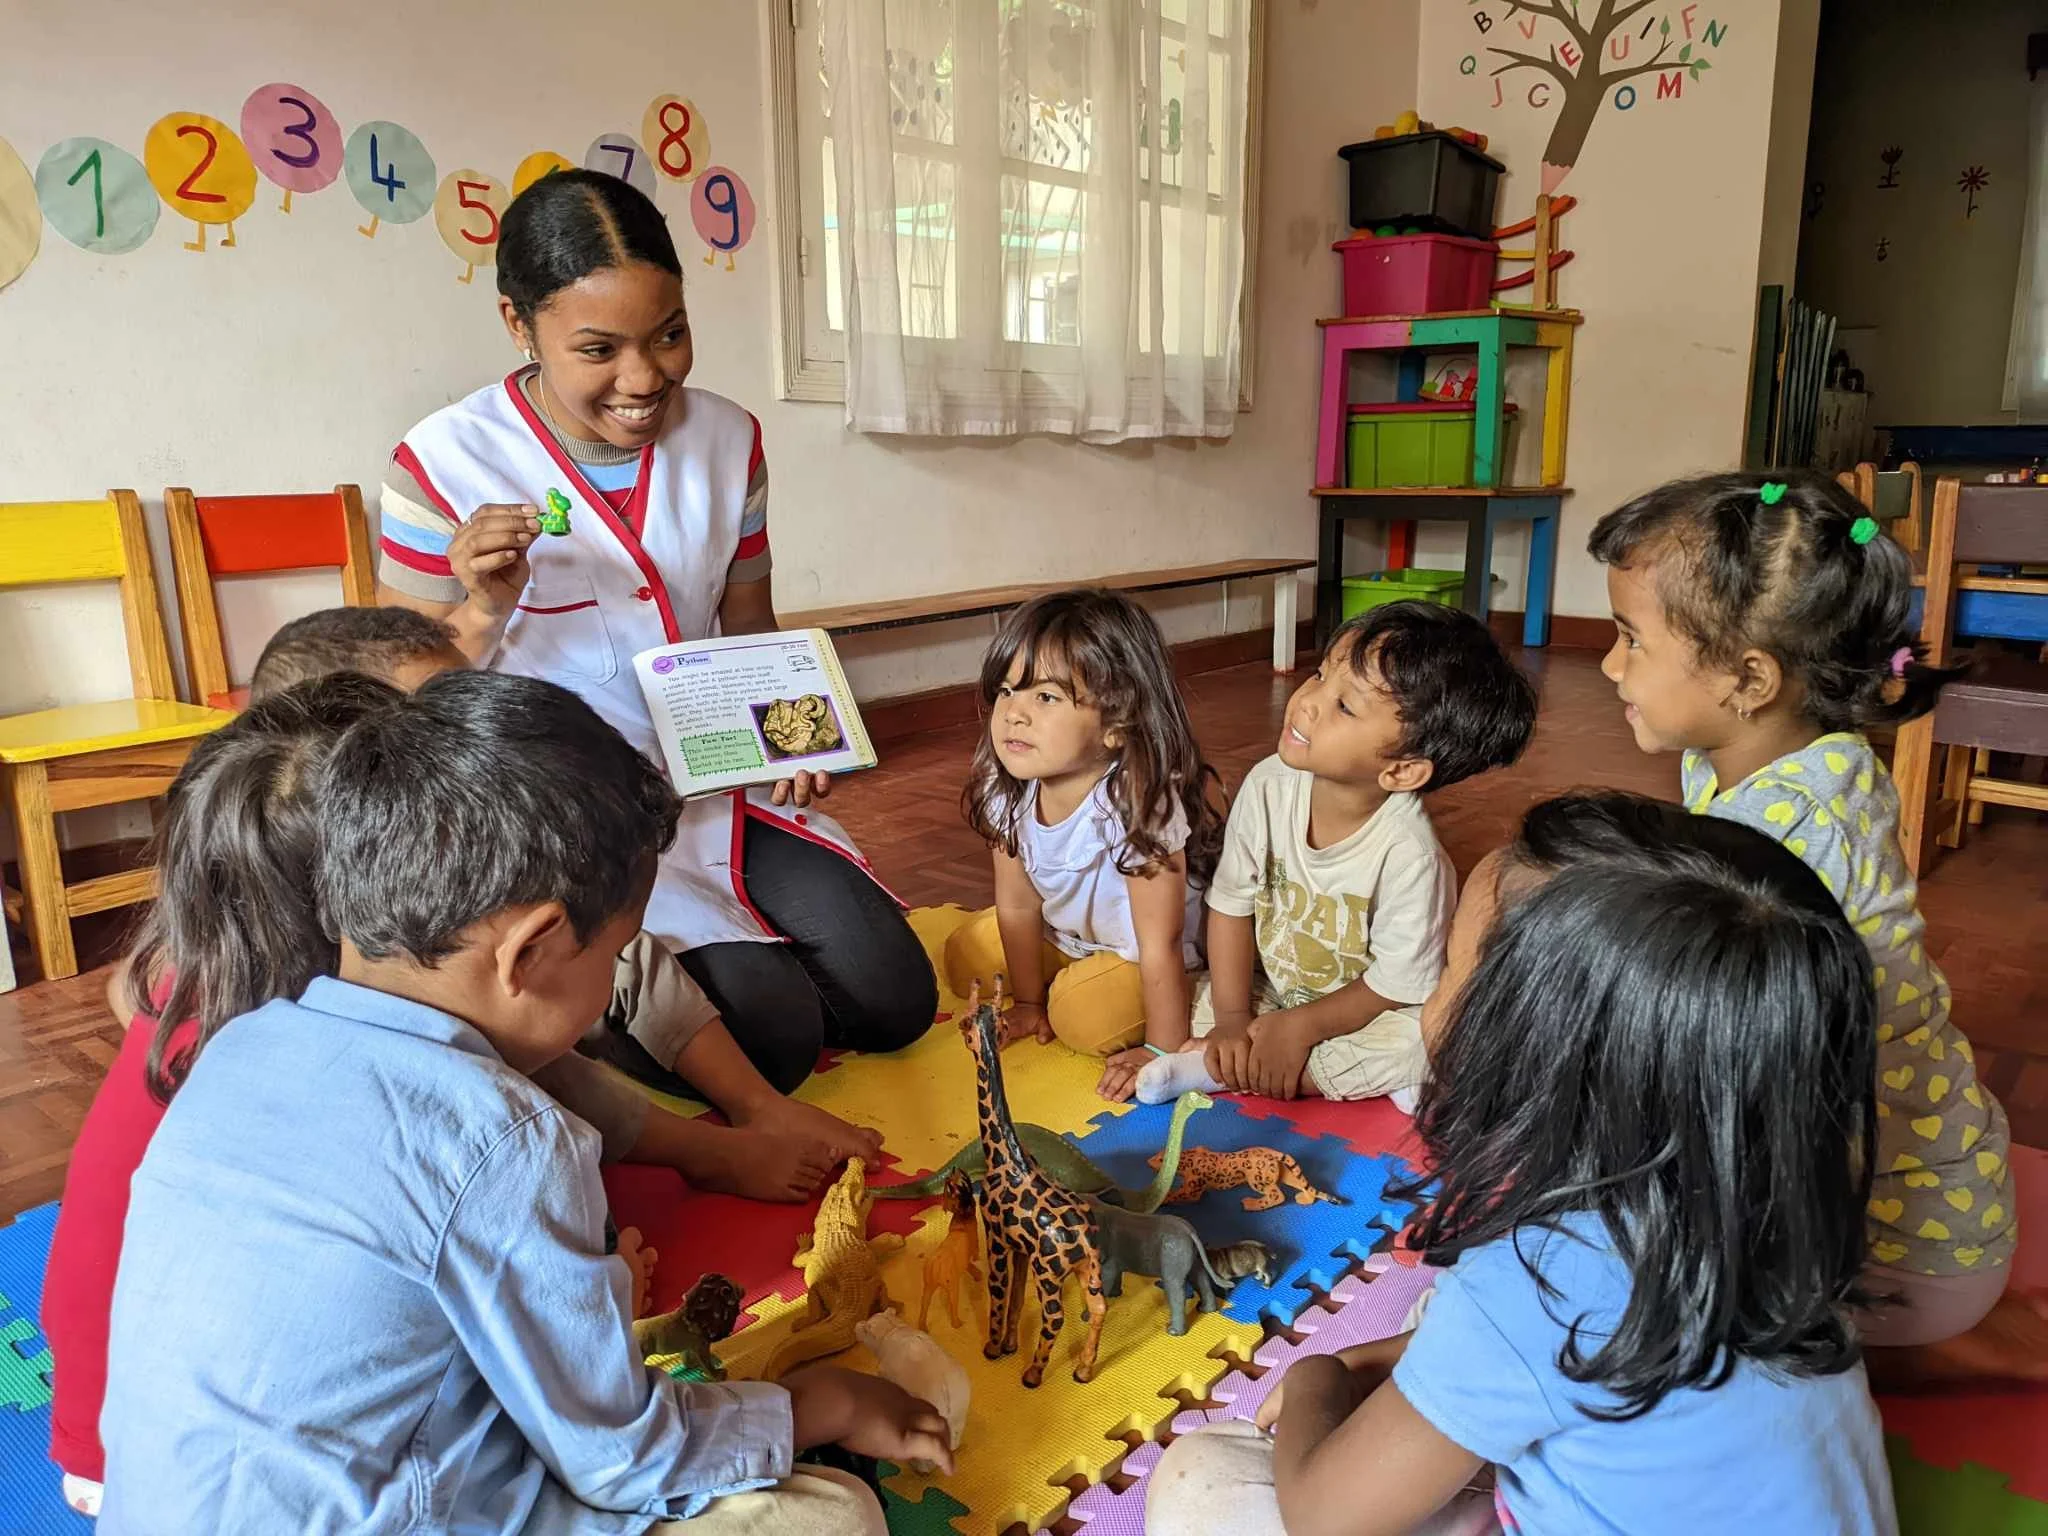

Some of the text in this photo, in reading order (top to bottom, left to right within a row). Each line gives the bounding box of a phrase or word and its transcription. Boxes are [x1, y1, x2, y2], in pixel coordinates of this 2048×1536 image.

[1473, 11, 1493, 34] B
[1517, 14, 1537, 40] V
[1681, 3, 1698, 40] F
[1701, 19, 1728, 48] N
[1558, 40, 1582, 67] E
[1610, 33, 1630, 61] U
[1459, 55, 1477, 76] Q
[1491, 77, 1503, 109] J
[1614, 85, 1637, 111] O
[1656, 71, 1682, 100] M
[270, 97, 320, 169] 3
[657, 101, 693, 178] 8
[175, 124, 228, 204] 2
[369, 134, 407, 202] 4
[67, 148, 103, 238] 1
[457, 180, 500, 245] 5
[703, 173, 740, 250] 9
[677, 657, 709, 666] Python
